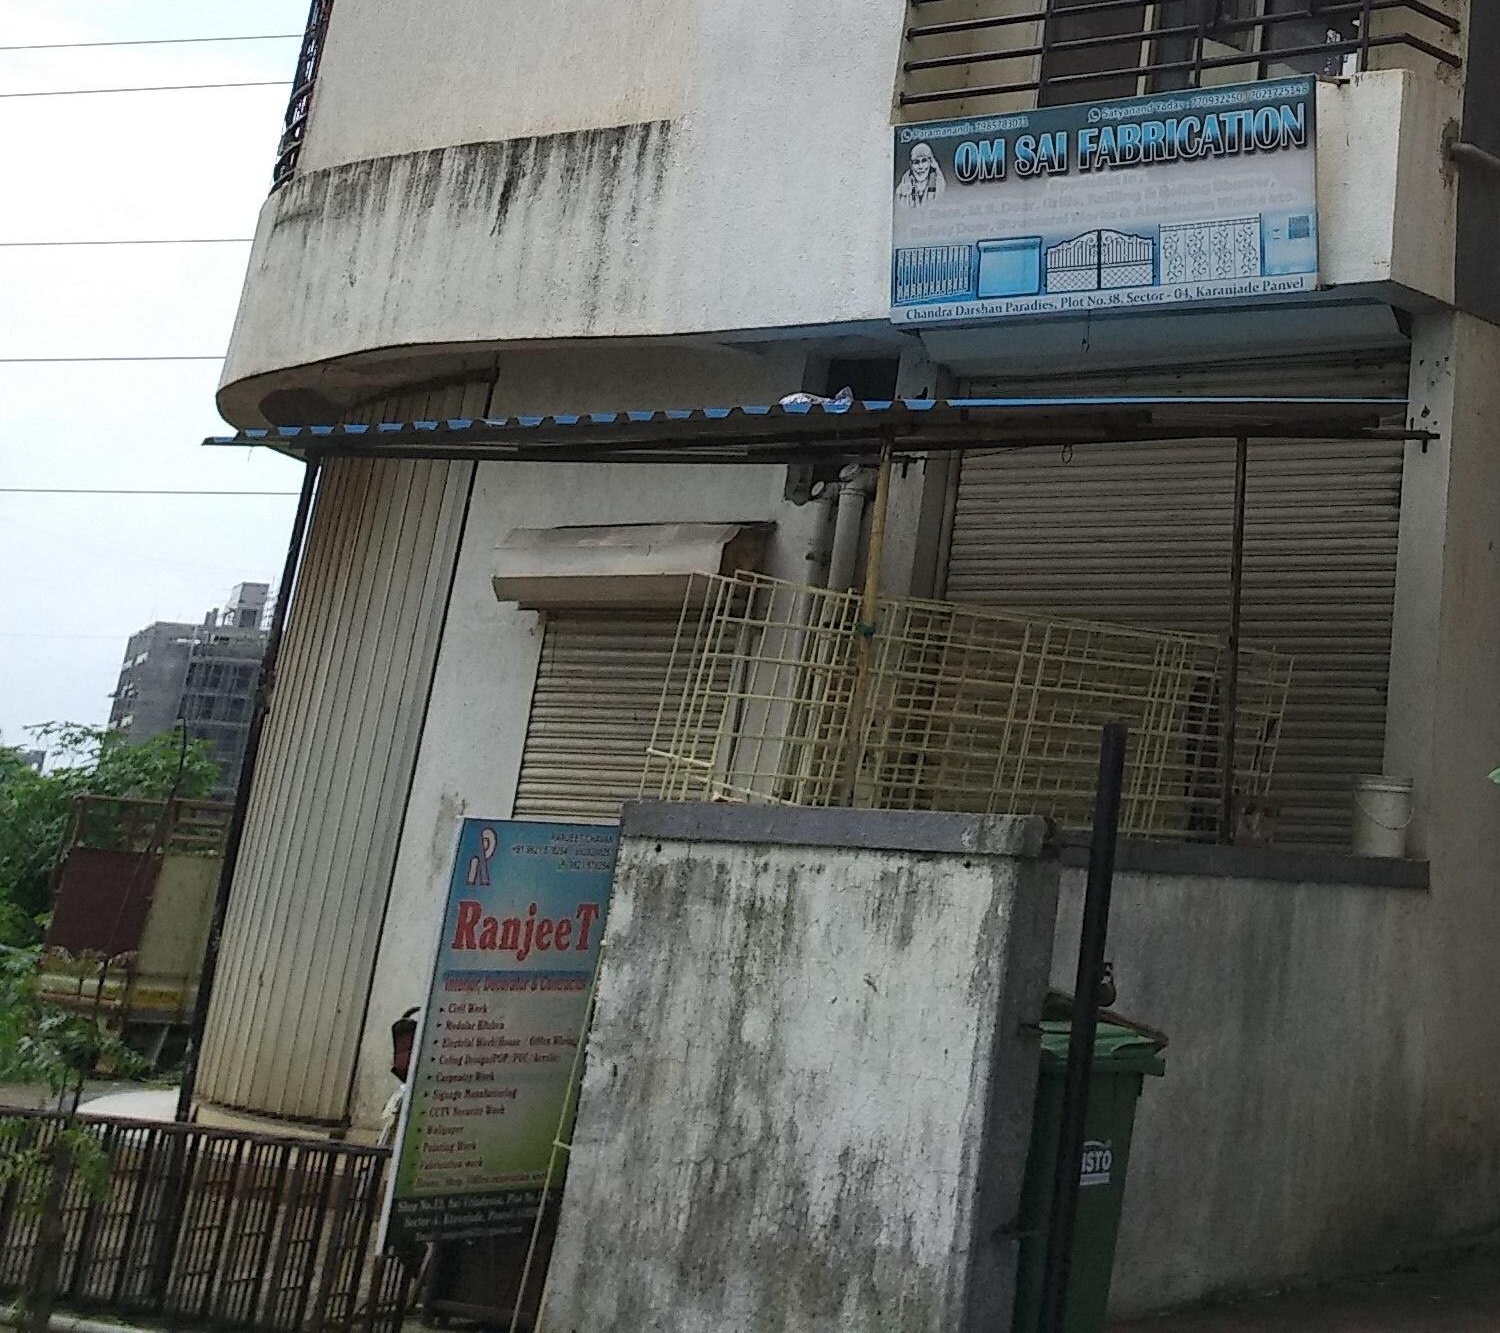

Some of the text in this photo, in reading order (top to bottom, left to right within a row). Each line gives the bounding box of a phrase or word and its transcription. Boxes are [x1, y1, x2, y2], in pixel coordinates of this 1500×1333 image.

[954, 102, 1306, 183] OM SAI FABRICATION
[906, 308, 952, 320] Chandra
[955, 302, 1003, 316] Darshan
[1060, 295, 1084, 309] Plot
[1126, 291, 1164, 304] Sector
[1196, 282, 1259, 300] Karanjade
[1263, 277, 1304, 293] Panvel
[451, 900, 600, 962] RanjeeT
